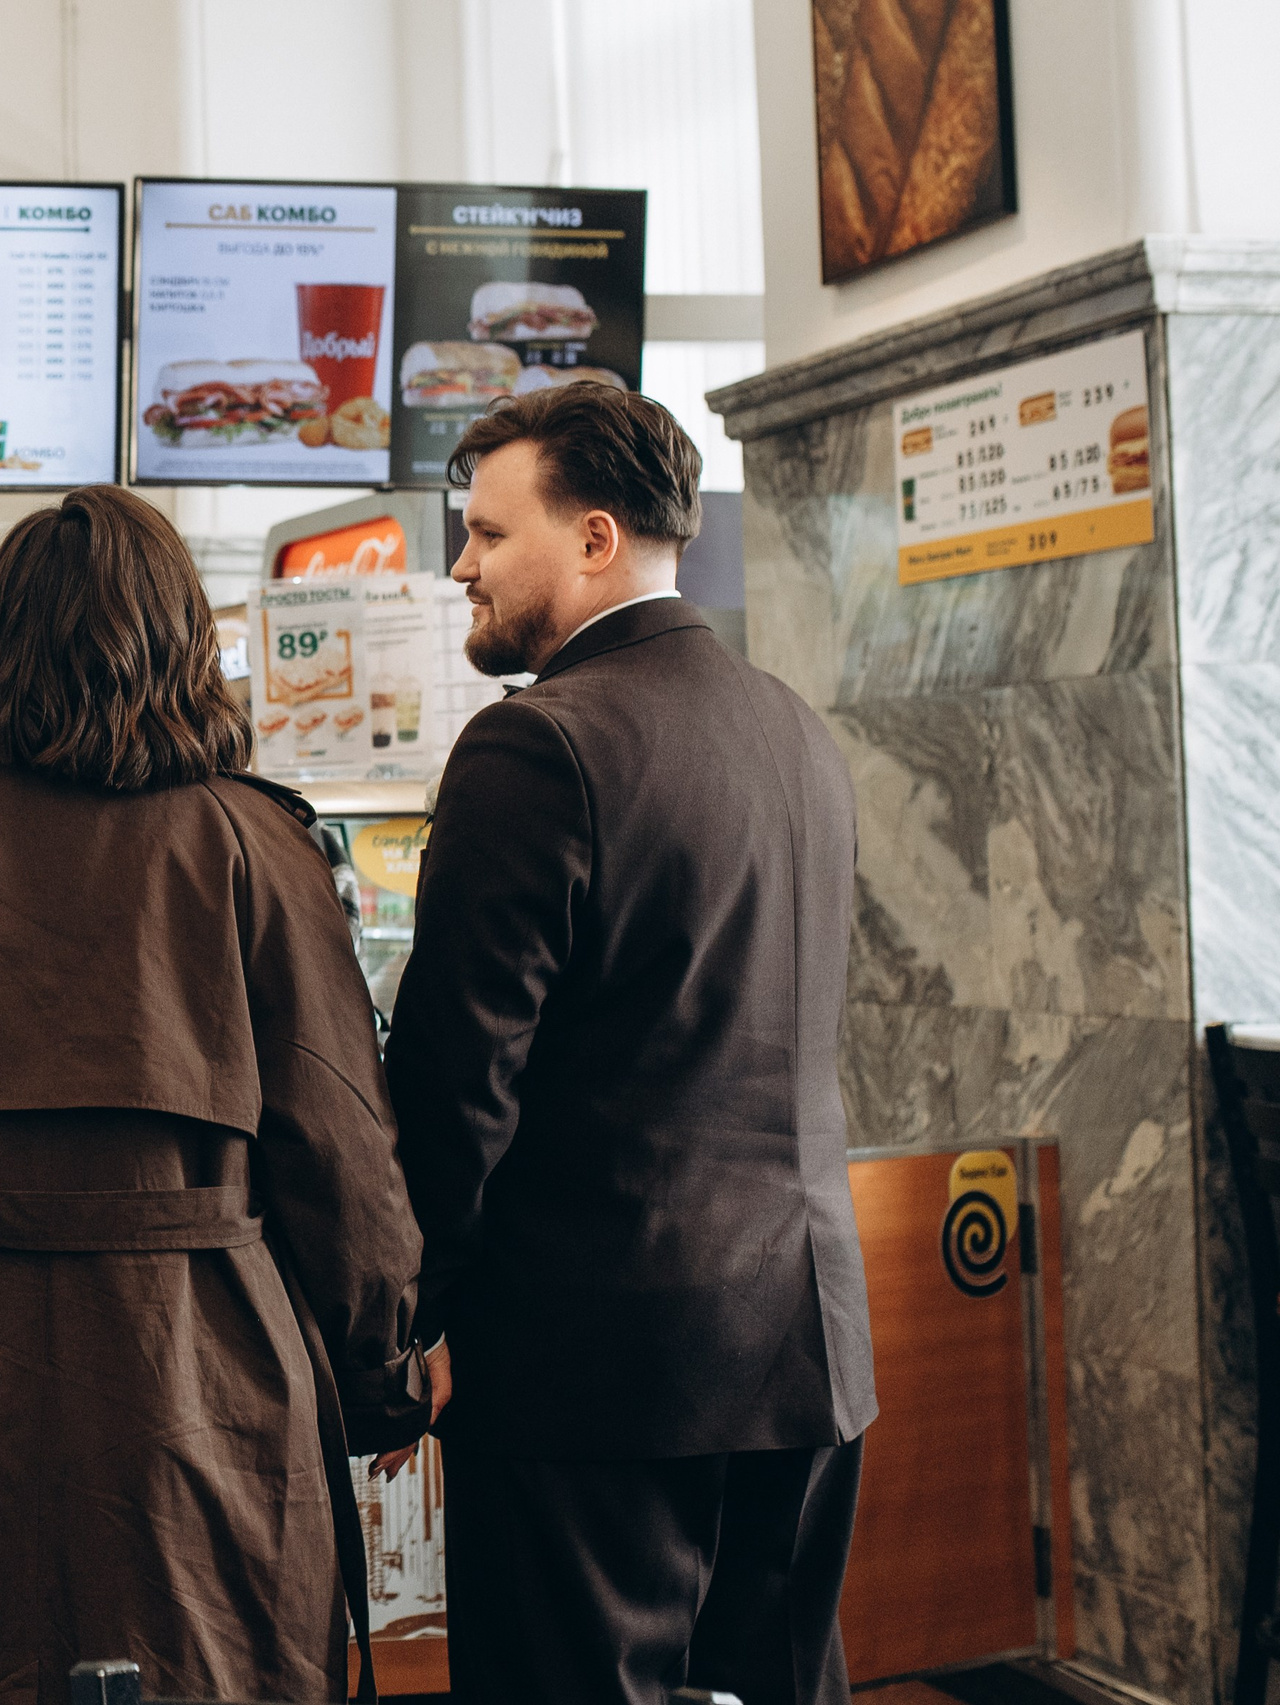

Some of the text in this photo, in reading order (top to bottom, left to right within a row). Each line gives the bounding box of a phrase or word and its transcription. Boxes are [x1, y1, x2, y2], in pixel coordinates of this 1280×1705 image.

[17, 206, 92, 221] КОМБО
[208, 204, 337, 223] САБ КОМБО
